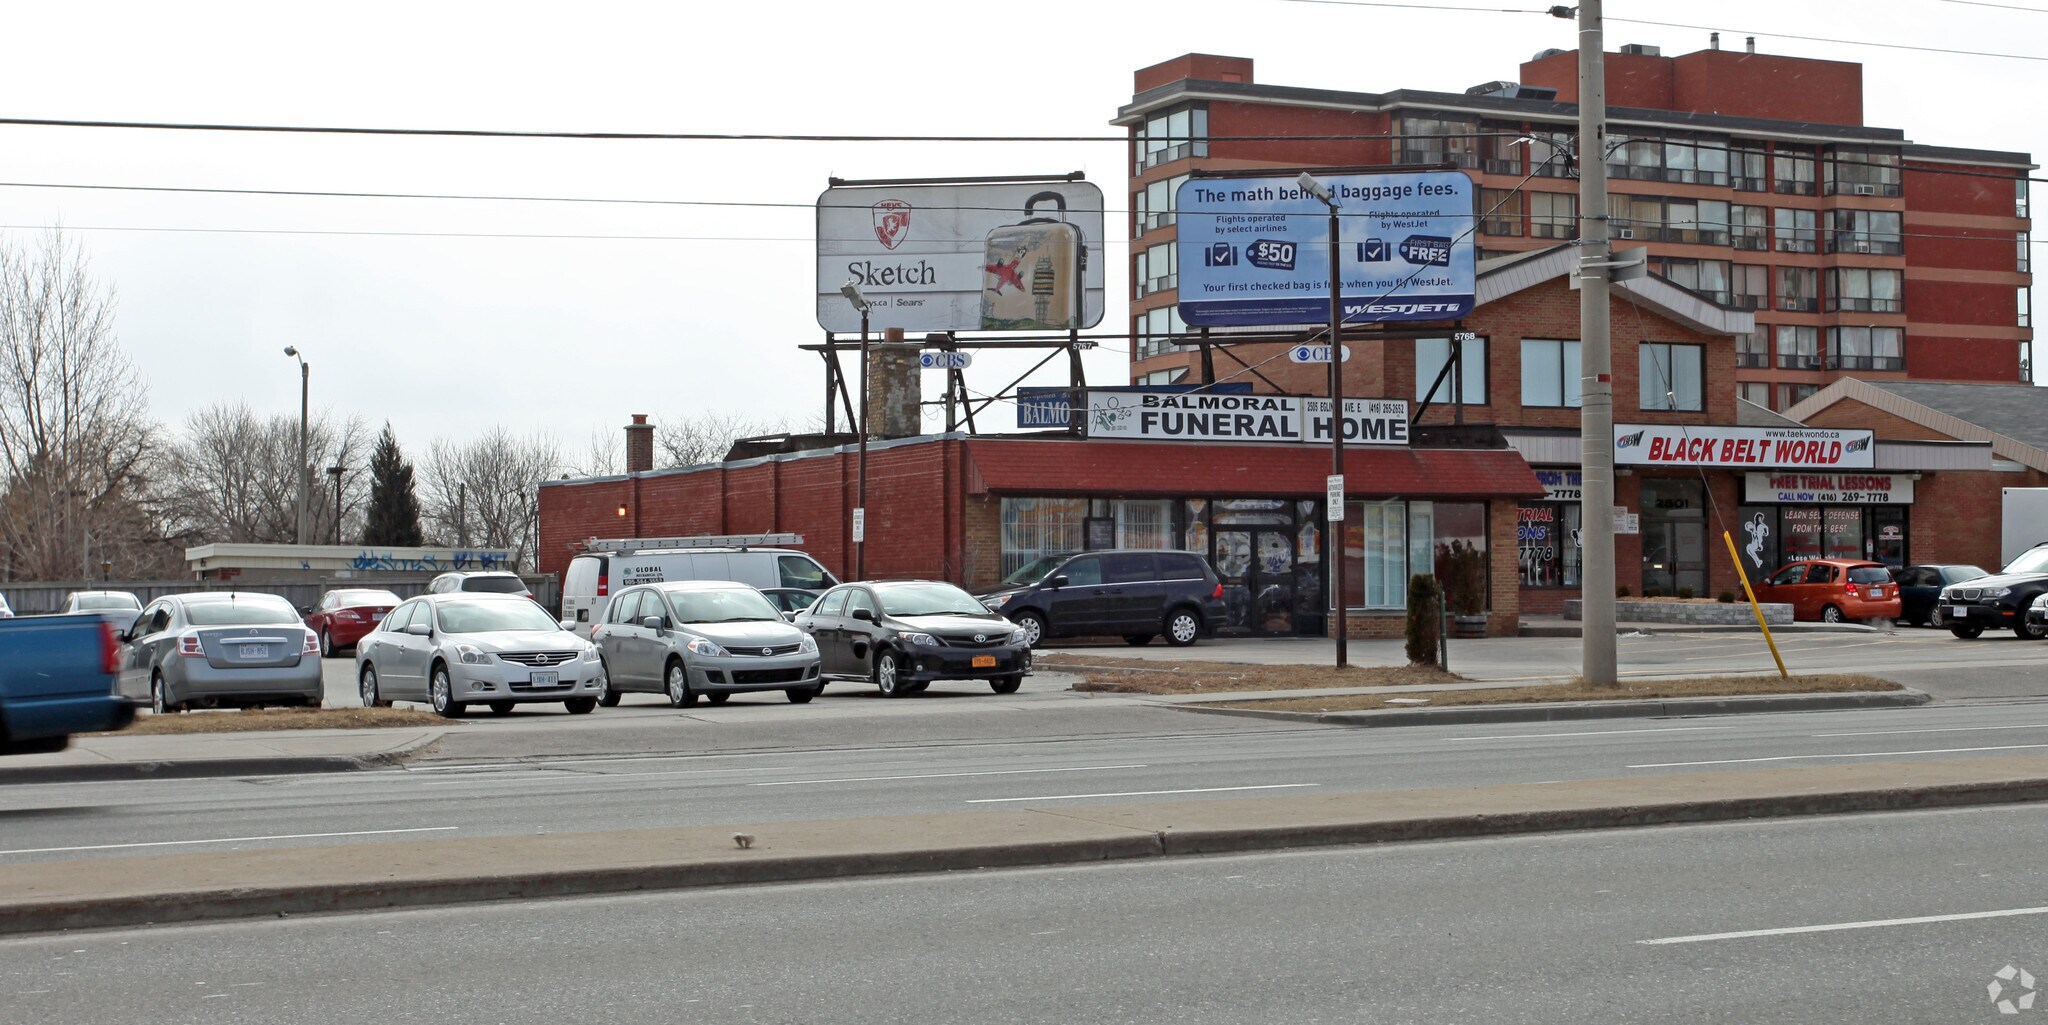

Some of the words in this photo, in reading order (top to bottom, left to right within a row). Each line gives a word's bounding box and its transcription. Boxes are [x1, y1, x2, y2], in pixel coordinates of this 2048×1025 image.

[1195, 188, 1226, 203] The
[1231, 187, 1273, 202] math
[1279, 184, 1335, 201] behd
[1341, 184, 1412, 202] baggage
[1417, 182, 1458, 197] fees.
[1216, 215, 1246, 225] Flights
[1247, 214, 1286, 224] operated
[1369, 210, 1399, 219] Flights
[1401, 209, 1440, 219] operated
[1215, 226, 1226, 235] by
[1227, 225, 1253, 234] select
[1254, 224, 1288, 233] airlines
[1381, 220, 1391, 230] by
[1393, 220, 1428, 229] WestJet
[1433, 241, 1450, 249] BAG
[1258, 242, 1293, 263] $50
[1409, 246, 1447, 262] FREE
[848, 259, 936, 287] Sketch
[1203, 283, 1226, 292] Your
[1228, 282, 1248, 292] first
[1250, 281, 1290, 291] checked
[1293, 281, 1311, 292] bag
[1313, 280, 1322, 289] is
[1324, 280, 1344, 289] fre
[1346, 279, 1373, 289] when
[1375, 281, 1393, 290] you
[1396, 278, 1408, 289] fly
[1411, 277, 1454, 288] WestJet.
[1344, 303, 1449, 315] WESTJET
[1455, 332, 1475, 341] 5768
[1072, 342, 1092, 350] 5767
[935, 353, 965, 367] CBS
[1312, 347, 1343, 361] CB
[1142, 395, 1296, 412] BALMORAL
[1344, 402, 1356, 413] AVE.
[1368, 401, 1380, 414] (416)
[1023, 401, 1070, 424] BALMO
[1141, 411, 1299, 438] FUNERAL
[1313, 417, 1407, 441] HOME
[1765, 430, 1840, 439] www.taekwondo.ca
[1648, 436, 1718, 461] BLACK
[1720, 438, 1772, 463] BELT
[1774, 440, 1842, 464] WORLD
[1769, 475, 1799, 490] FREE
[1800, 475, 1836, 490] TRIAL
[1838, 475, 1892, 491] LESSONS
[1778, 492, 1796, 501] CALL
[1797, 492, 1814, 501] NOW
[1818, 493, 1837, 502] (416)
[1516, 508, 1553, 522] TRIAL
[1784, 510, 1808, 520] LEARN
[1828, 511, 1860, 520] DEFENSE
[1792, 524, 1812, 533] FROM
[1830, 524, 1847, 533] BEST
